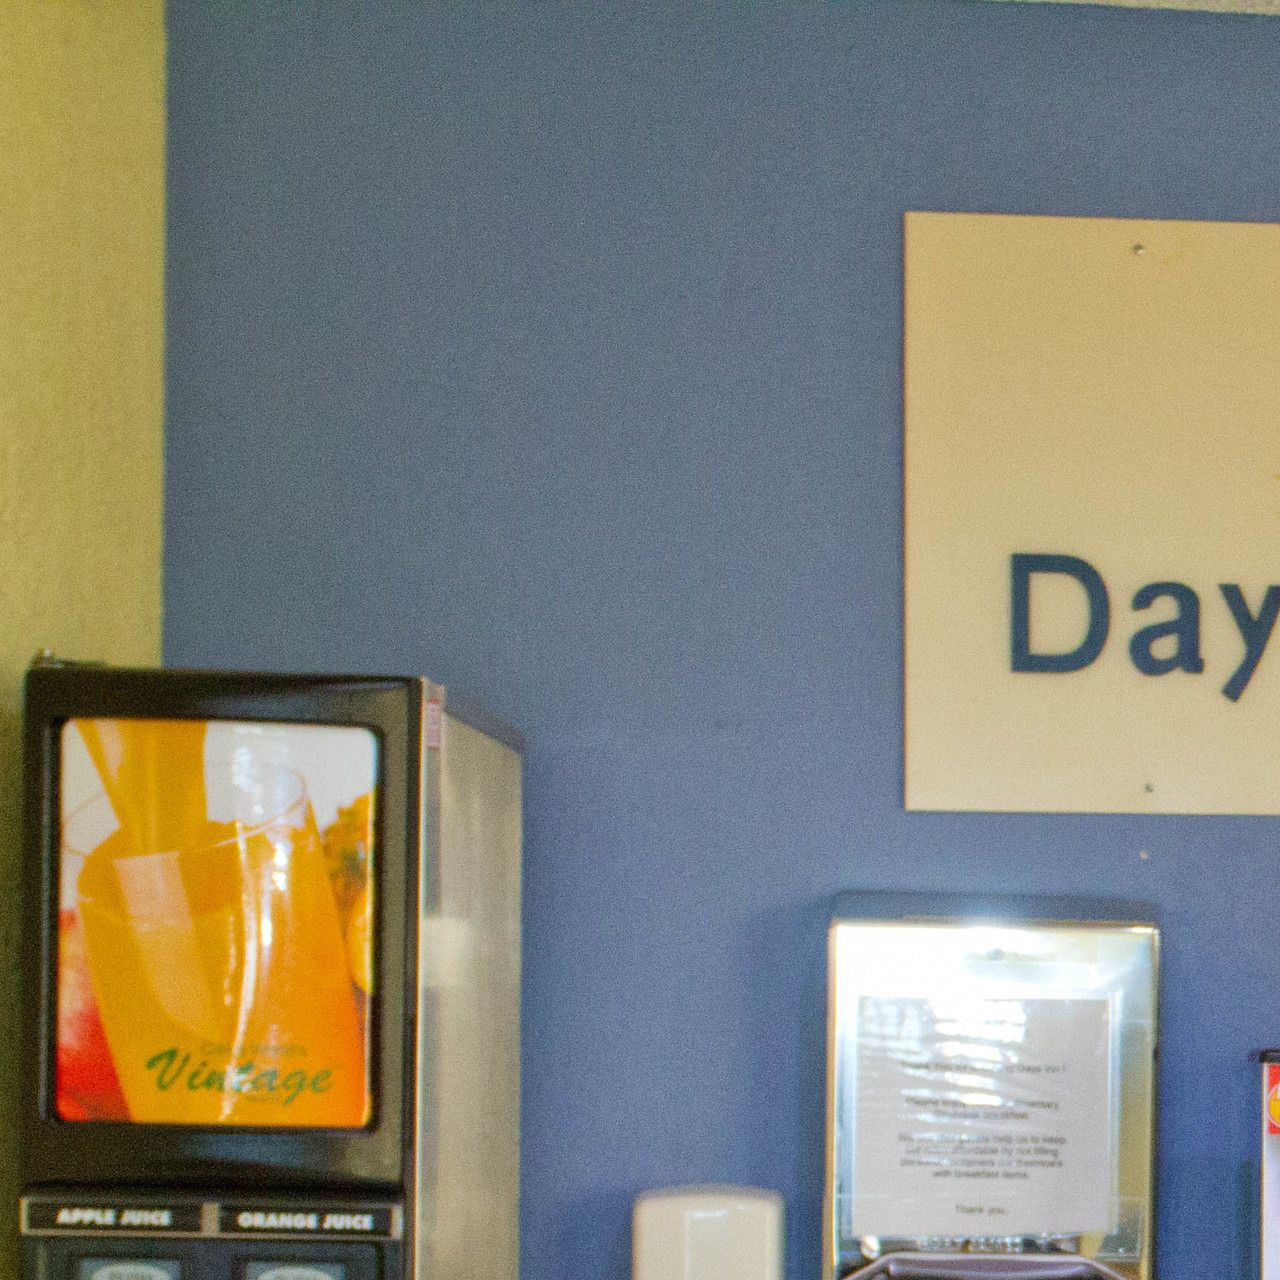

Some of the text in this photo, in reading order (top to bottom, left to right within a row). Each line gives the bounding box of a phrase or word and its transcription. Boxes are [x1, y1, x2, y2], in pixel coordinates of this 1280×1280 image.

[145, 1047, 333, 1107] Vintage
[56, 1208, 172, 1227] APPLE JUICE
[237, 1212, 374, 1231] ORANGE JUICE
